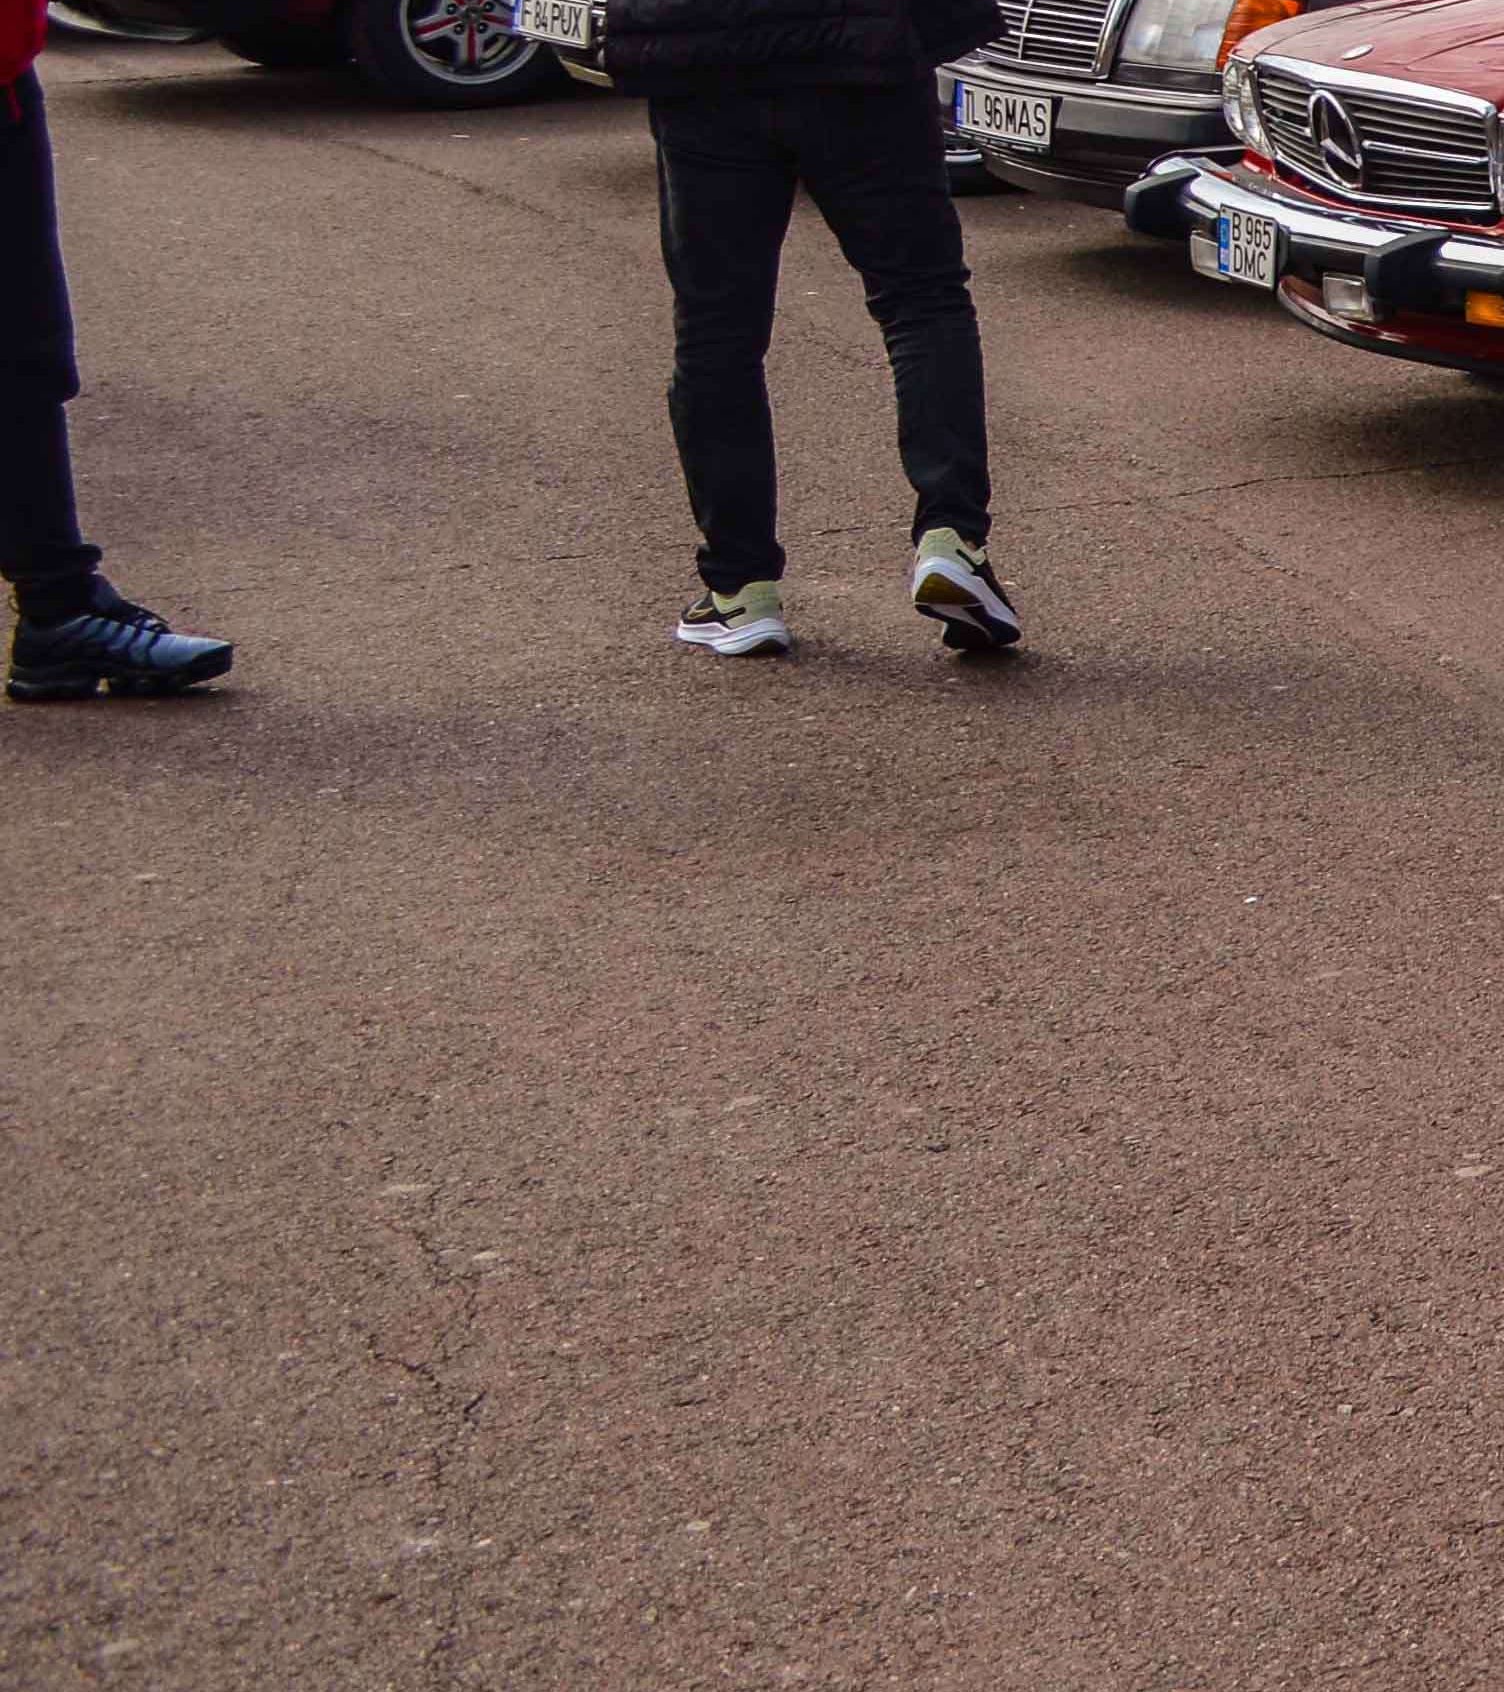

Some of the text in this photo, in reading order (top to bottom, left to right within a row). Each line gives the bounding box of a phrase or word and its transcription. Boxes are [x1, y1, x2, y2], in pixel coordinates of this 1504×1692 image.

[963, 88, 980, 126] TL
[1232, 212, 1274, 250] B 965
[1233, 244, 1267, 280] DMC
